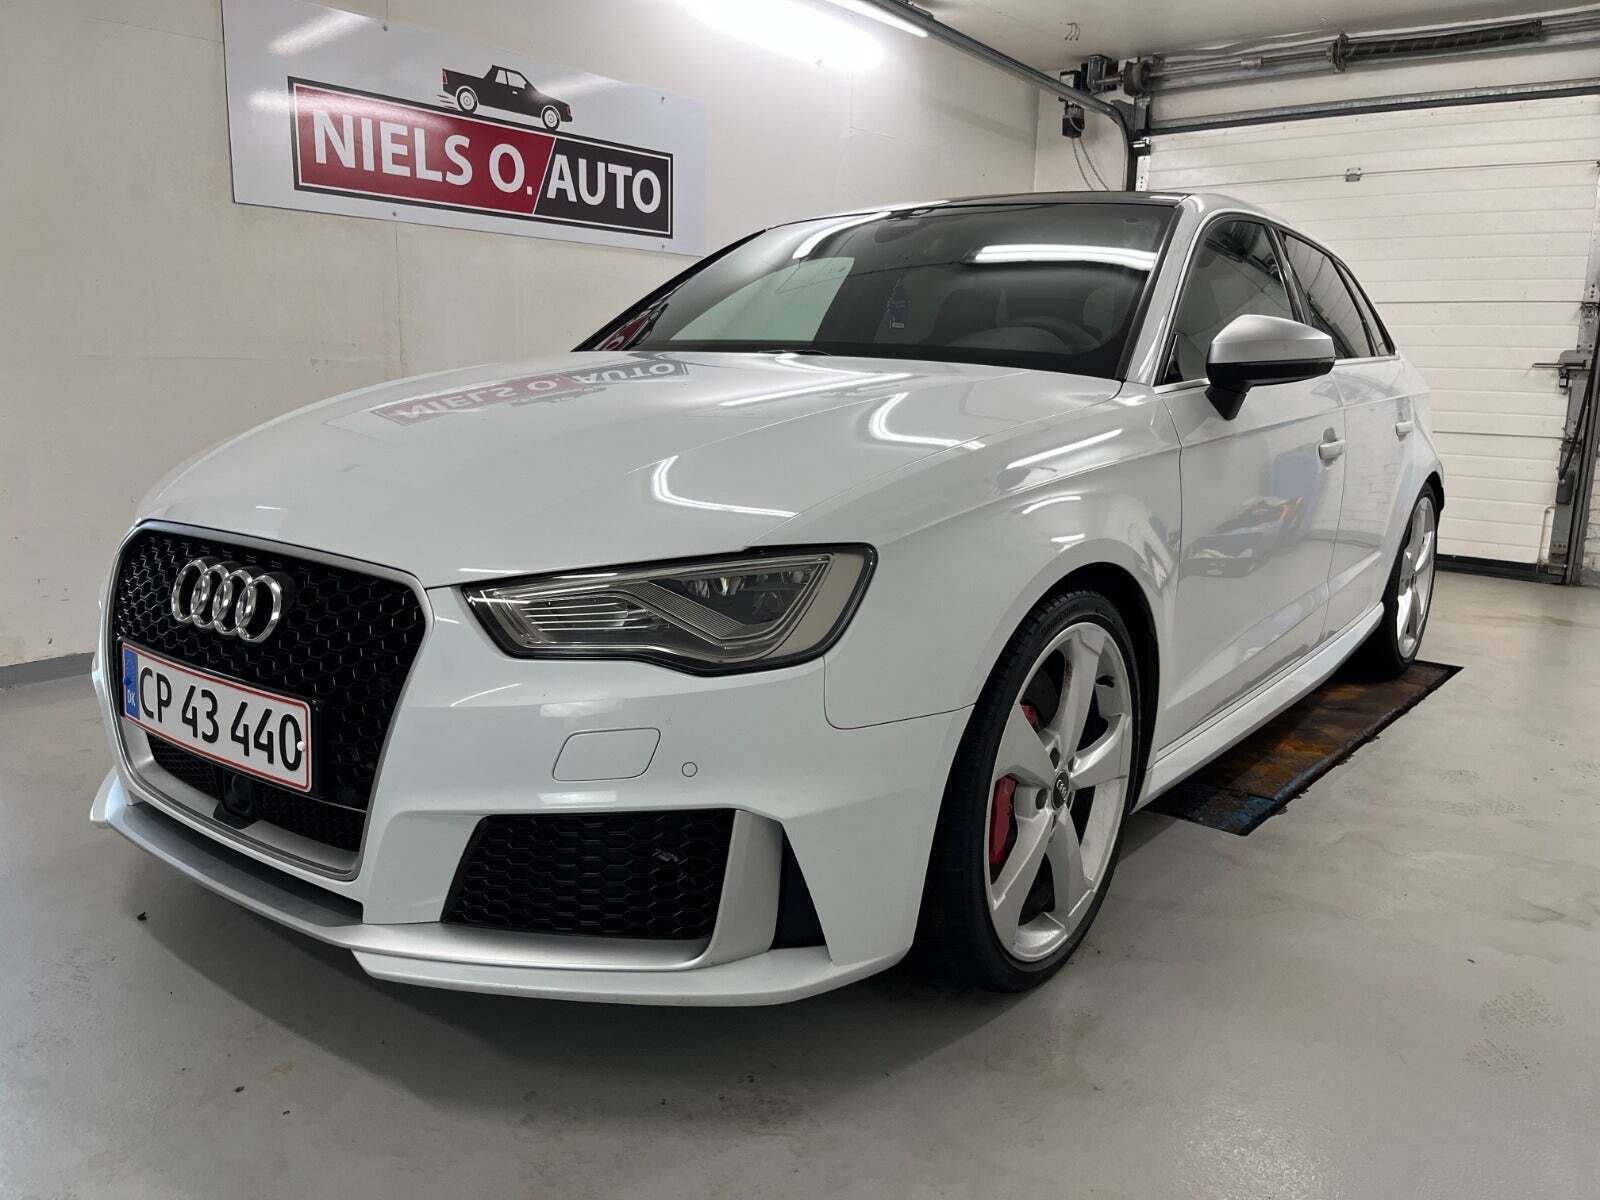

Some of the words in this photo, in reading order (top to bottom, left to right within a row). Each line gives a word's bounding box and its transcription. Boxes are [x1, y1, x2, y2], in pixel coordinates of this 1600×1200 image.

[313, 109, 473, 187] NIELS
[488, 143, 534, 196] O.
[547, 154, 662, 214] AUTO
[139, 666, 173, 724] CP
[181, 684, 220, 744] 43
[230, 701, 302, 772] 440
